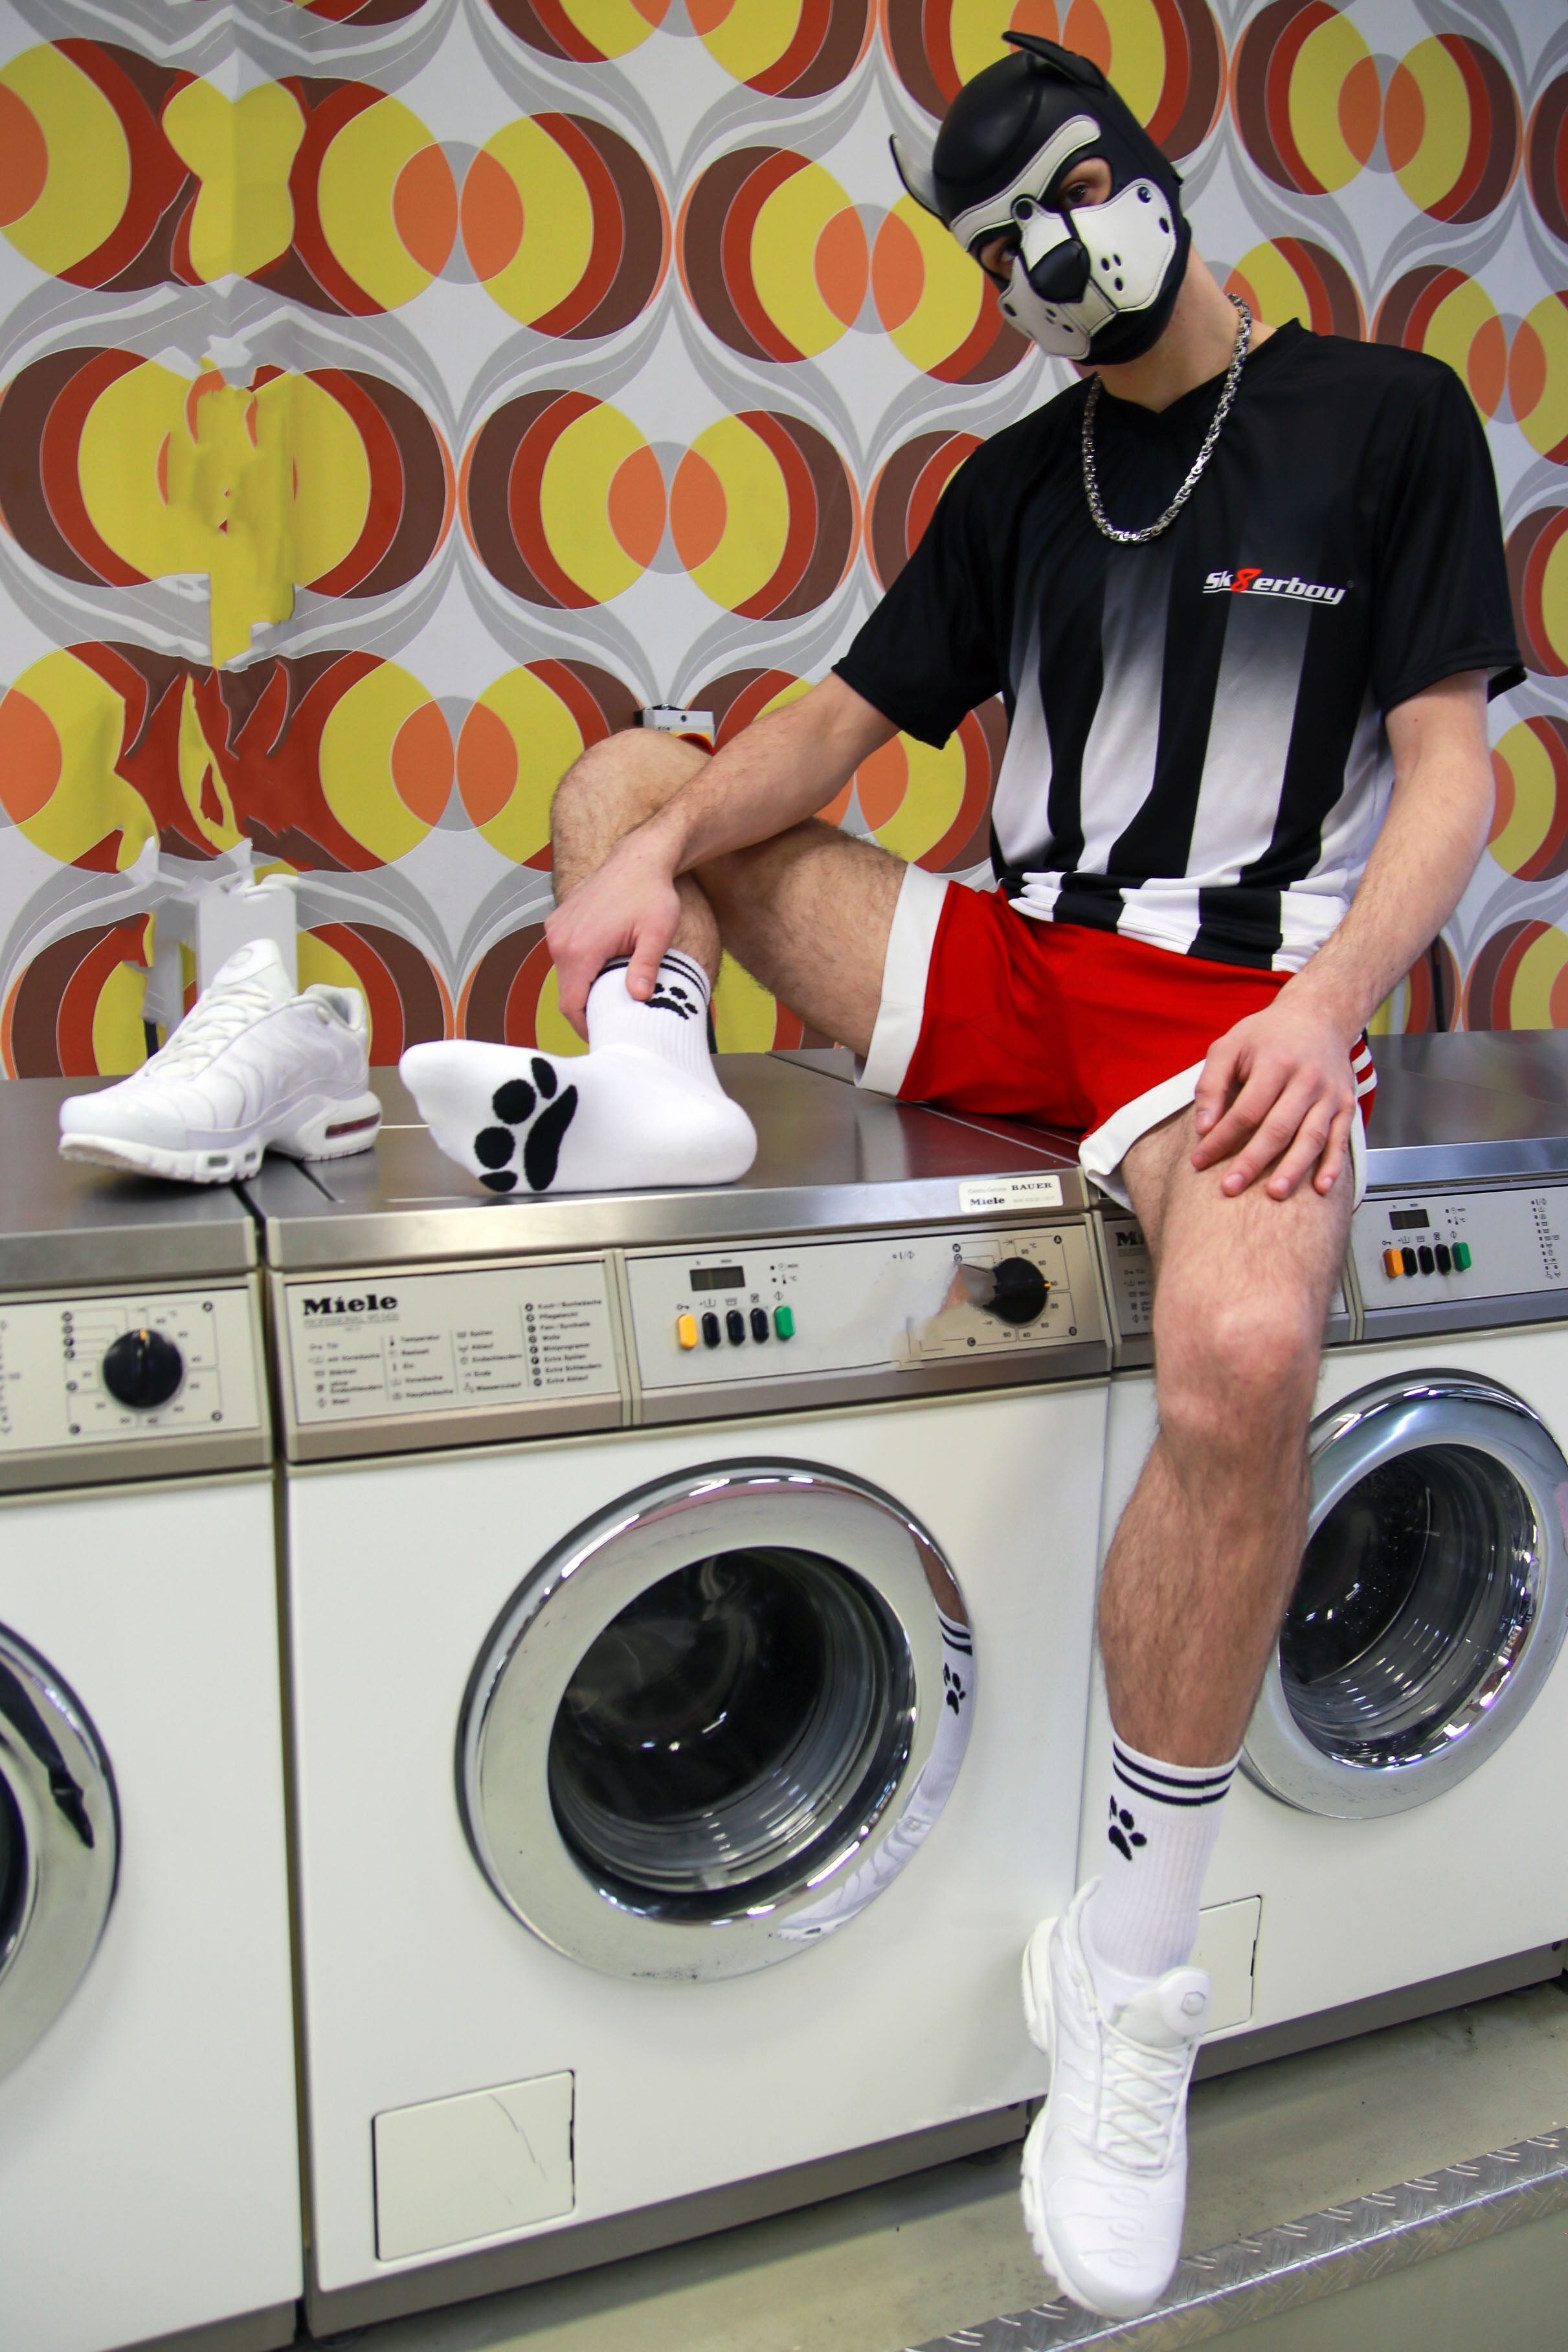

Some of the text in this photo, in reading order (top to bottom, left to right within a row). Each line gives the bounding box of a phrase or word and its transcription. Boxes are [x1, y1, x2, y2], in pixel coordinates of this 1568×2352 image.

[1202, 567, 1347, 605] Sk8erboy
[1011, 1182, 1052, 1191] BAUER
[970, 1197, 1005, 1206] Miele
[302, 1295, 398, 1316] Miele
